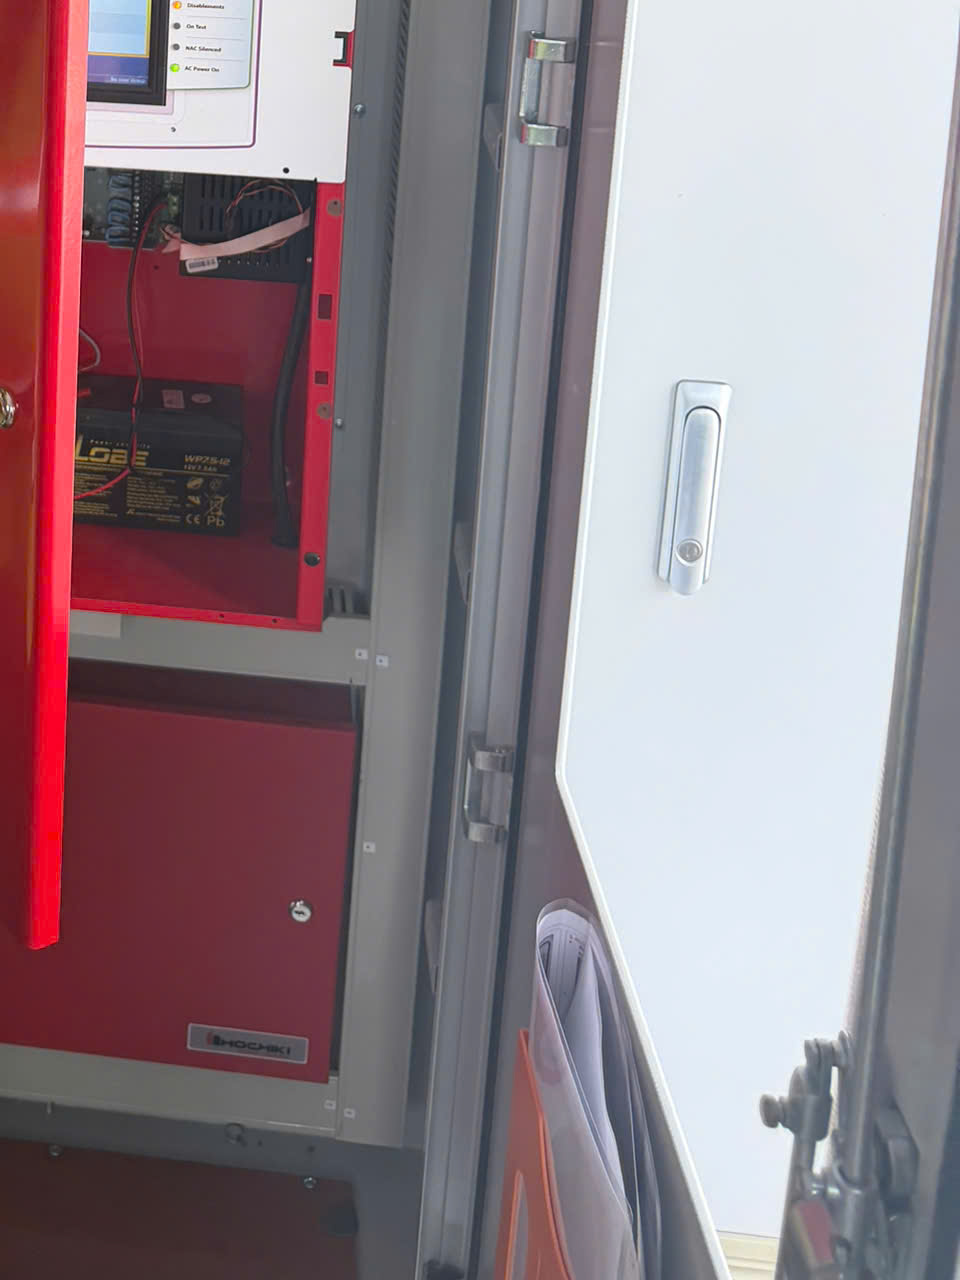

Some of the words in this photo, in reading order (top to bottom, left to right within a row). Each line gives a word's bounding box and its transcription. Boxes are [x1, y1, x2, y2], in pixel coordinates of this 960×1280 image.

[75, 433, 150, 467] LOBE
[207, 516, 225, 527] Pb
[219, 1038, 291, 1055] HOCHIKI
